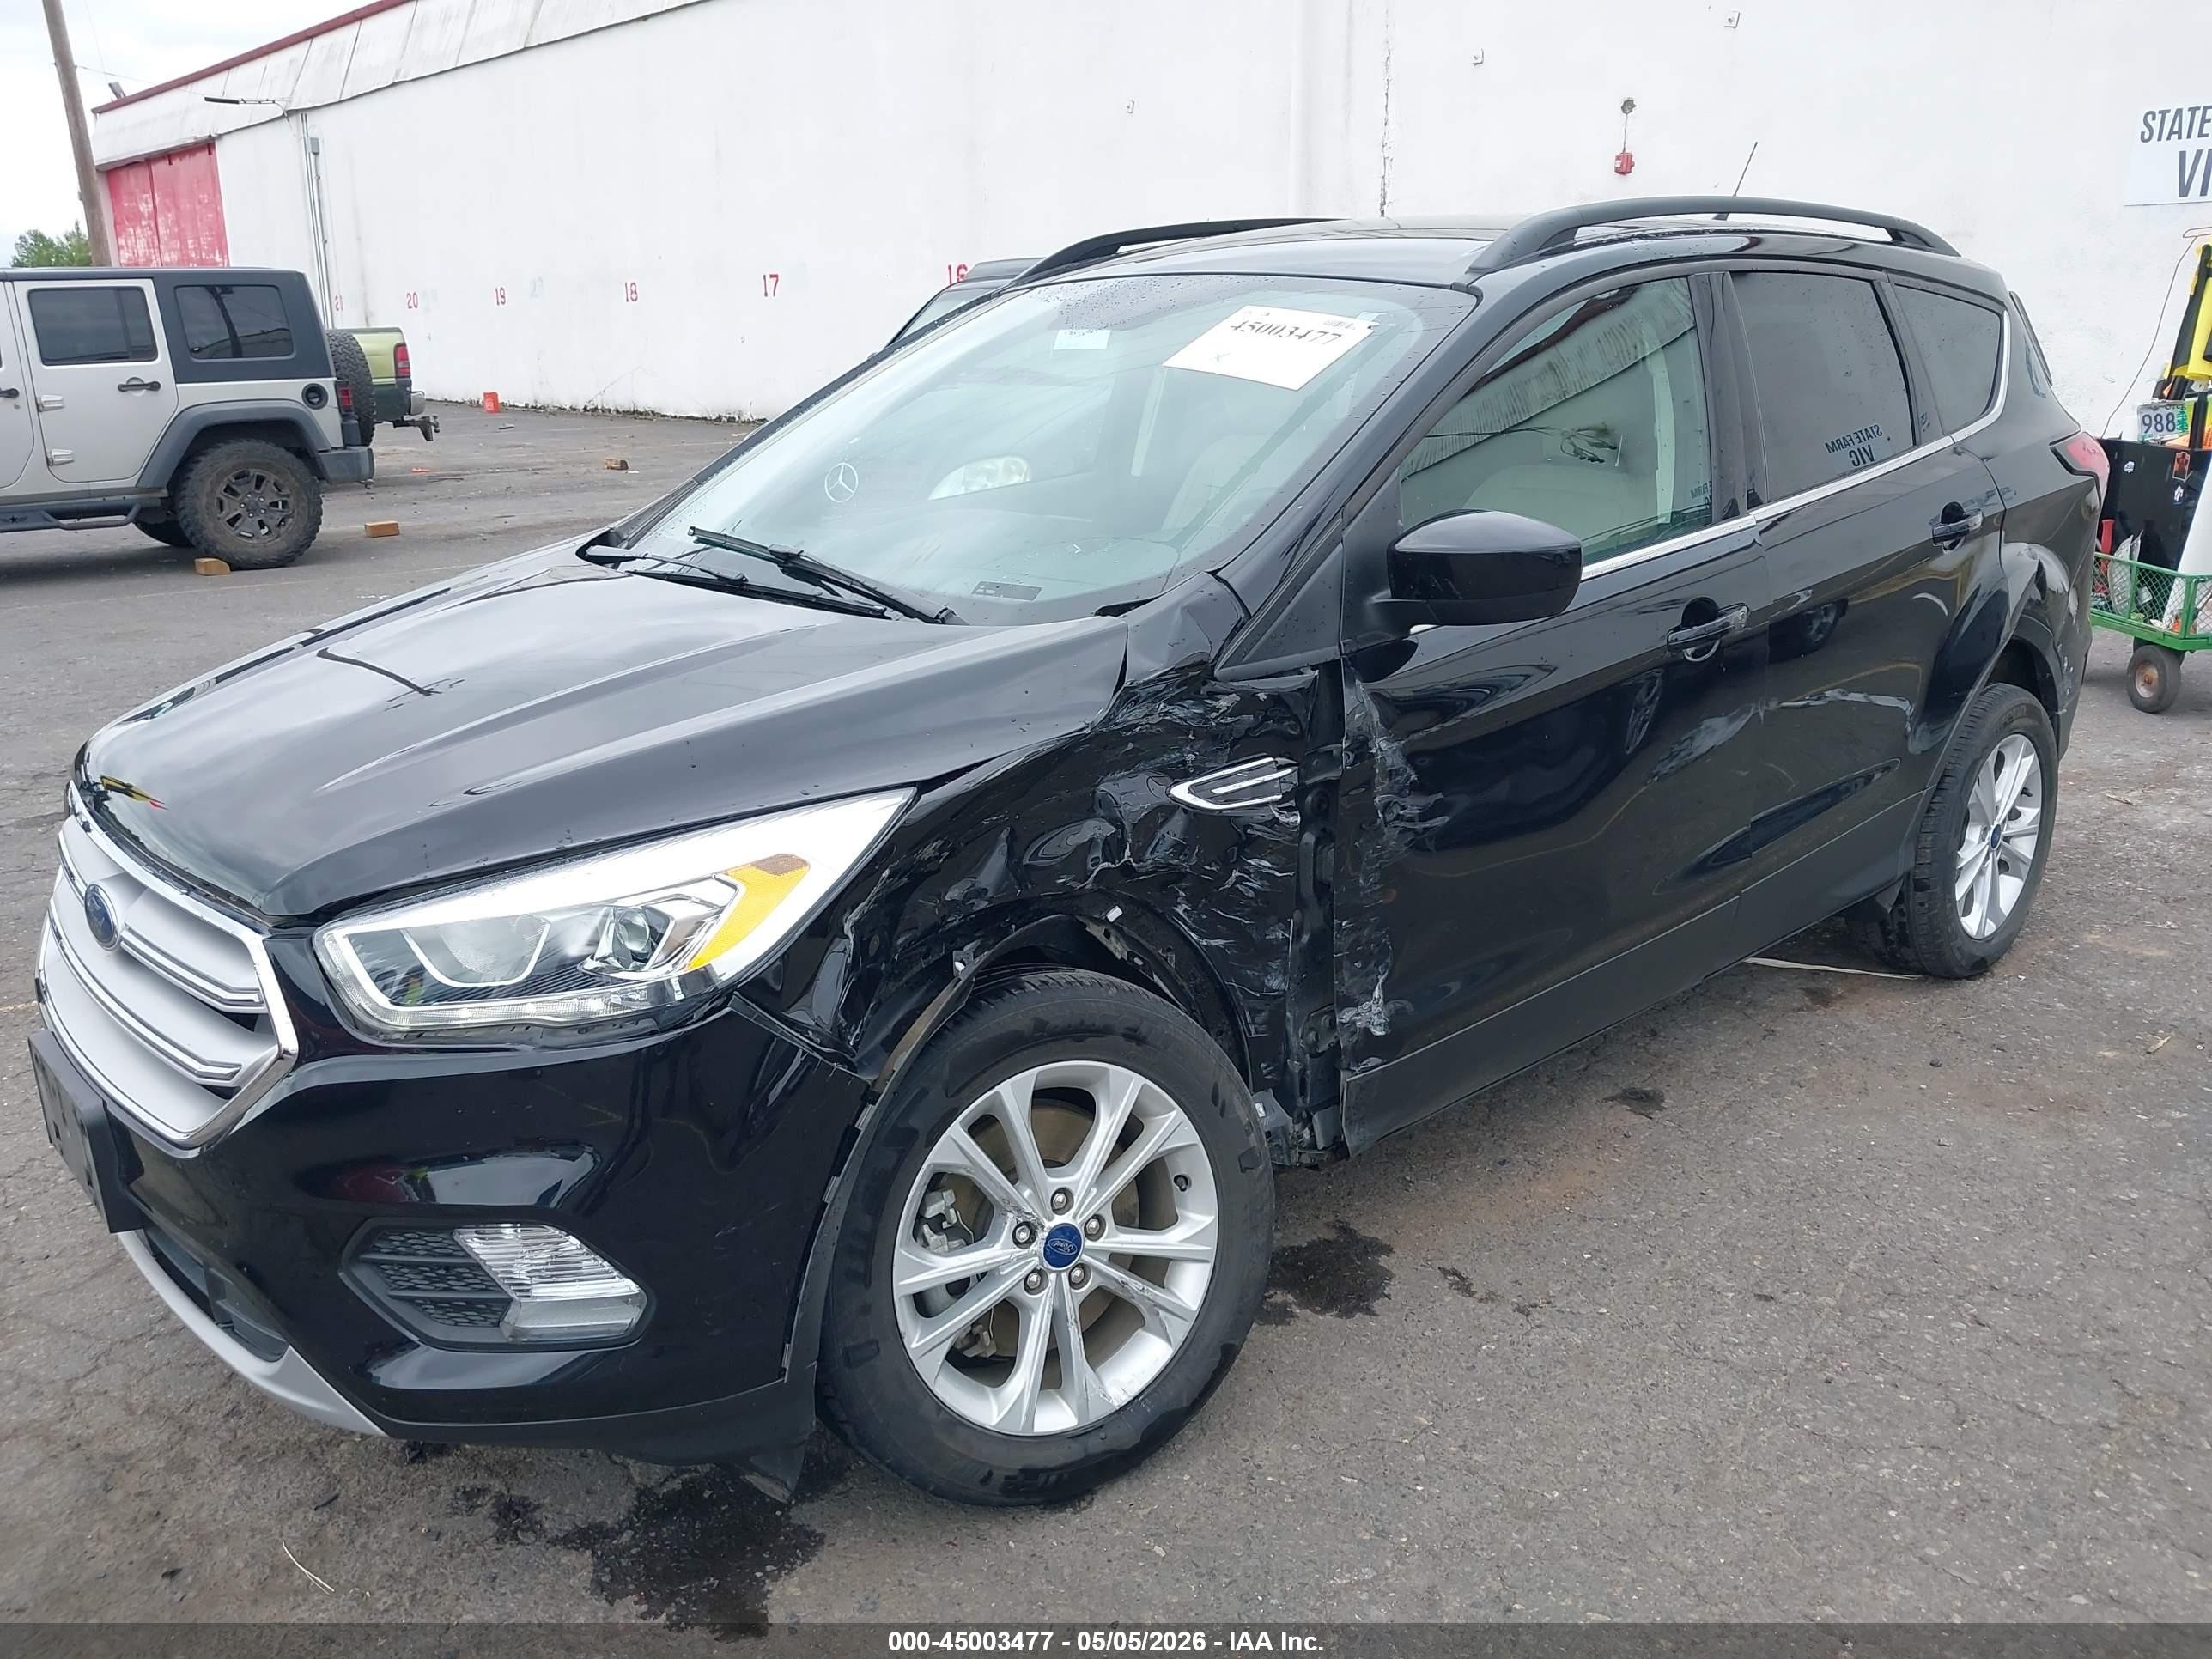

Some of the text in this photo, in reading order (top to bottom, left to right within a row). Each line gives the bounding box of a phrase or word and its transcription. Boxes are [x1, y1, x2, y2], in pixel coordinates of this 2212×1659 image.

[2141, 106, 2212, 143] STATE
[625, 282, 638, 302] 18
[763, 274, 779, 297] 17
[406, 292, 418, 309] 20
[495, 287, 507, 306] 19
[1231, 320, 1342, 344] 45003477
[2142, 412, 2176, 433] 988
